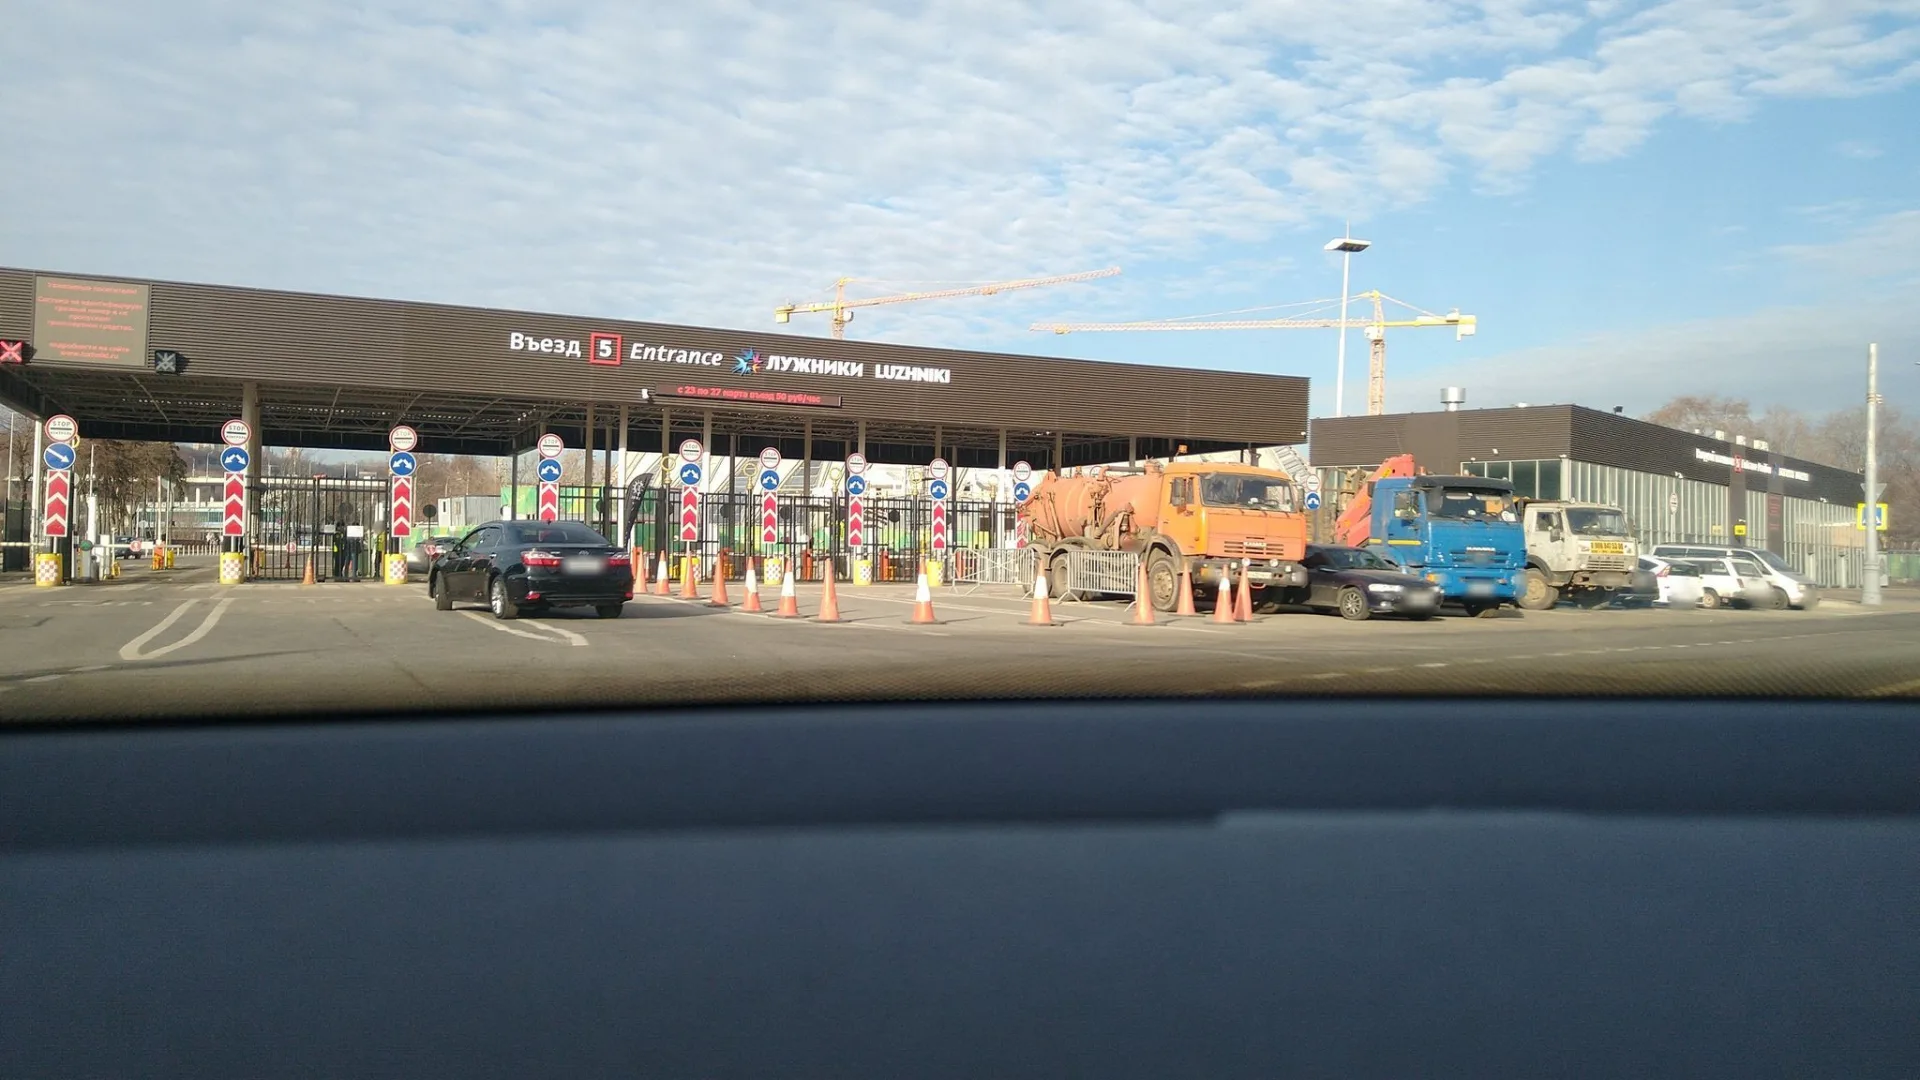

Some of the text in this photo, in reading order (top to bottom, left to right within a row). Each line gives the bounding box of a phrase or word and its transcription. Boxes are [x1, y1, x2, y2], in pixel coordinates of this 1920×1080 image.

[509, 332, 723, 366] Въезд 5 Entrance
[766, 355, 951, 383] ЛУЖНИКИ LUZHNIKI
[685, 386, 696, 394] 23
[697, 388, 709, 396] по
[710, 388, 721, 396] 27
